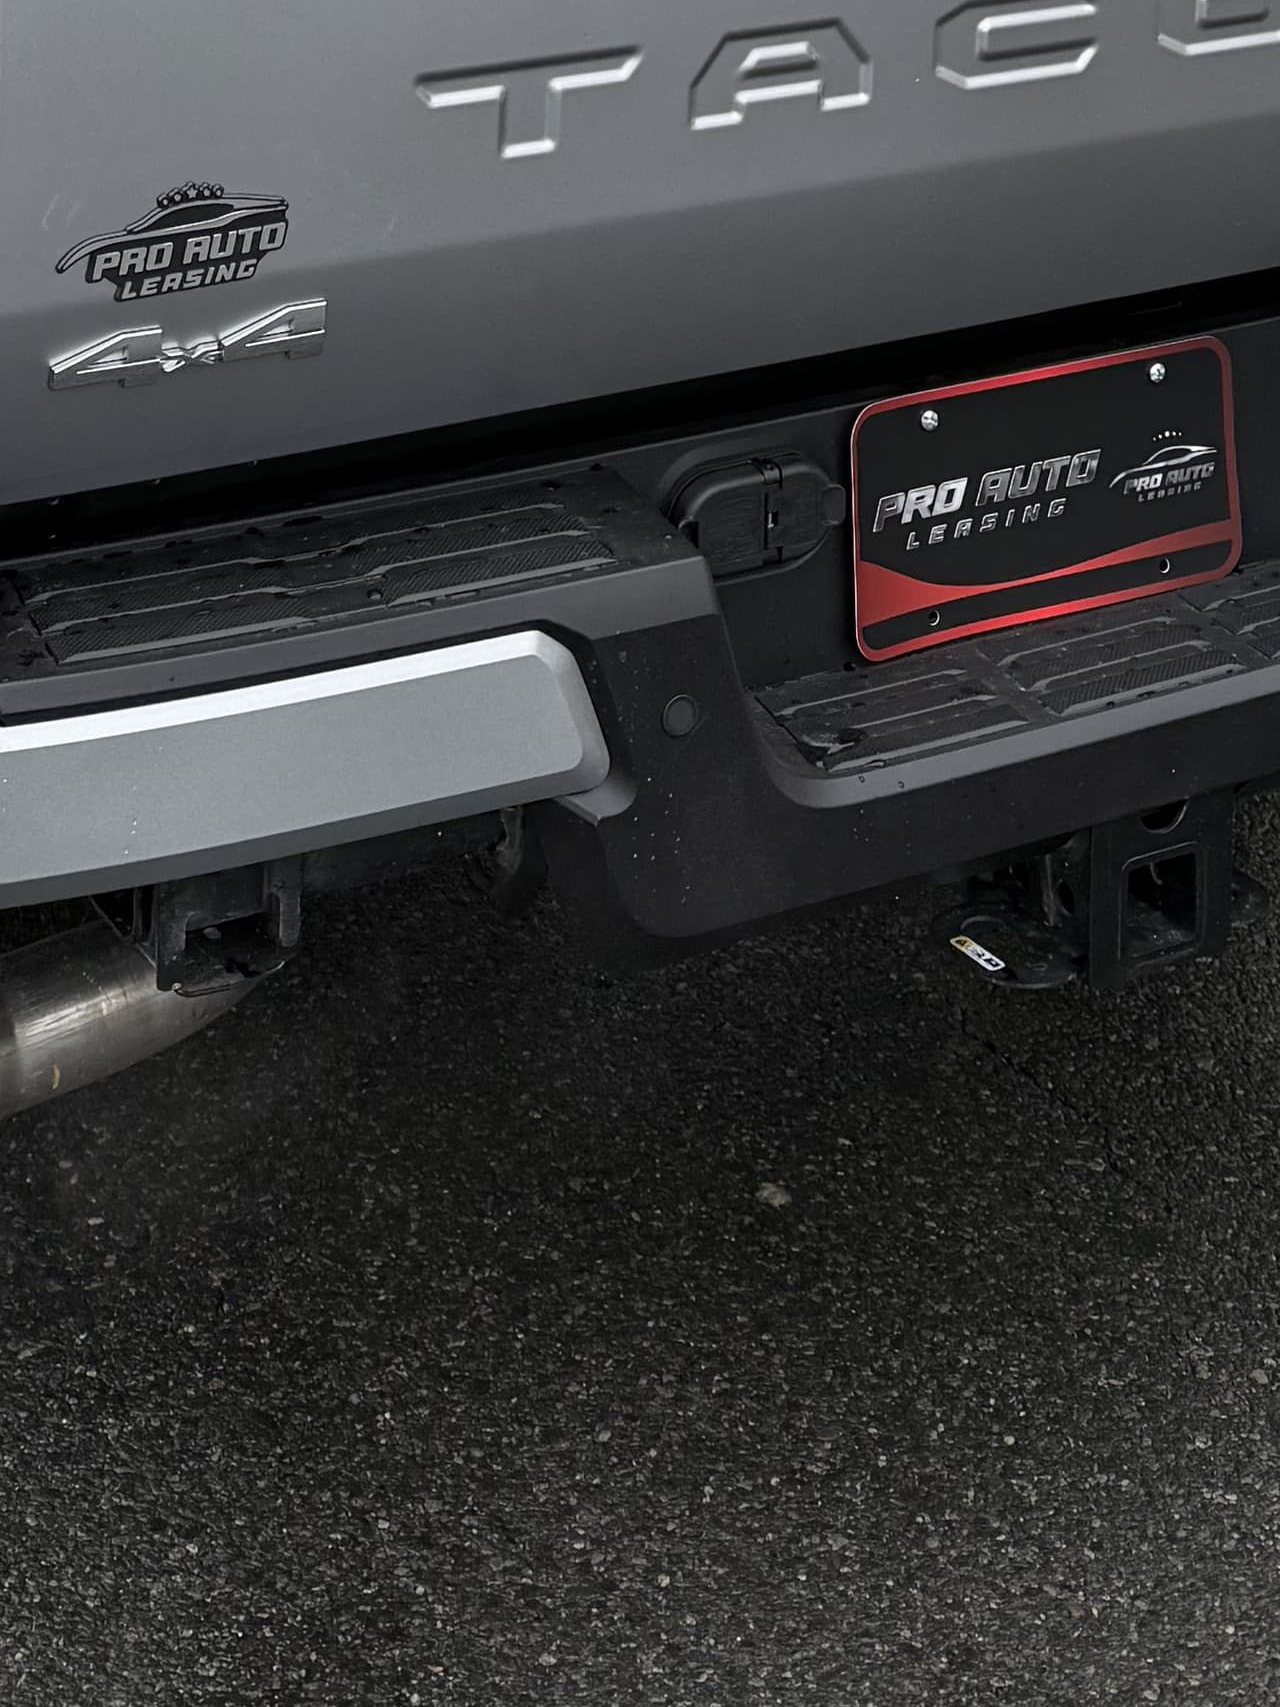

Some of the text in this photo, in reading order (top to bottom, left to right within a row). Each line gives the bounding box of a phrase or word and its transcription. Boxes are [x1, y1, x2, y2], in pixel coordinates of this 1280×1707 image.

[92, 222, 287, 281] PRO AUTO
[120, 258, 258, 301] LEASING
[873, 448, 1102, 534] PRO AUTO
[1123, 461, 1216, 495] PRO AUTO
[906, 497, 1068, 551] LEASING
